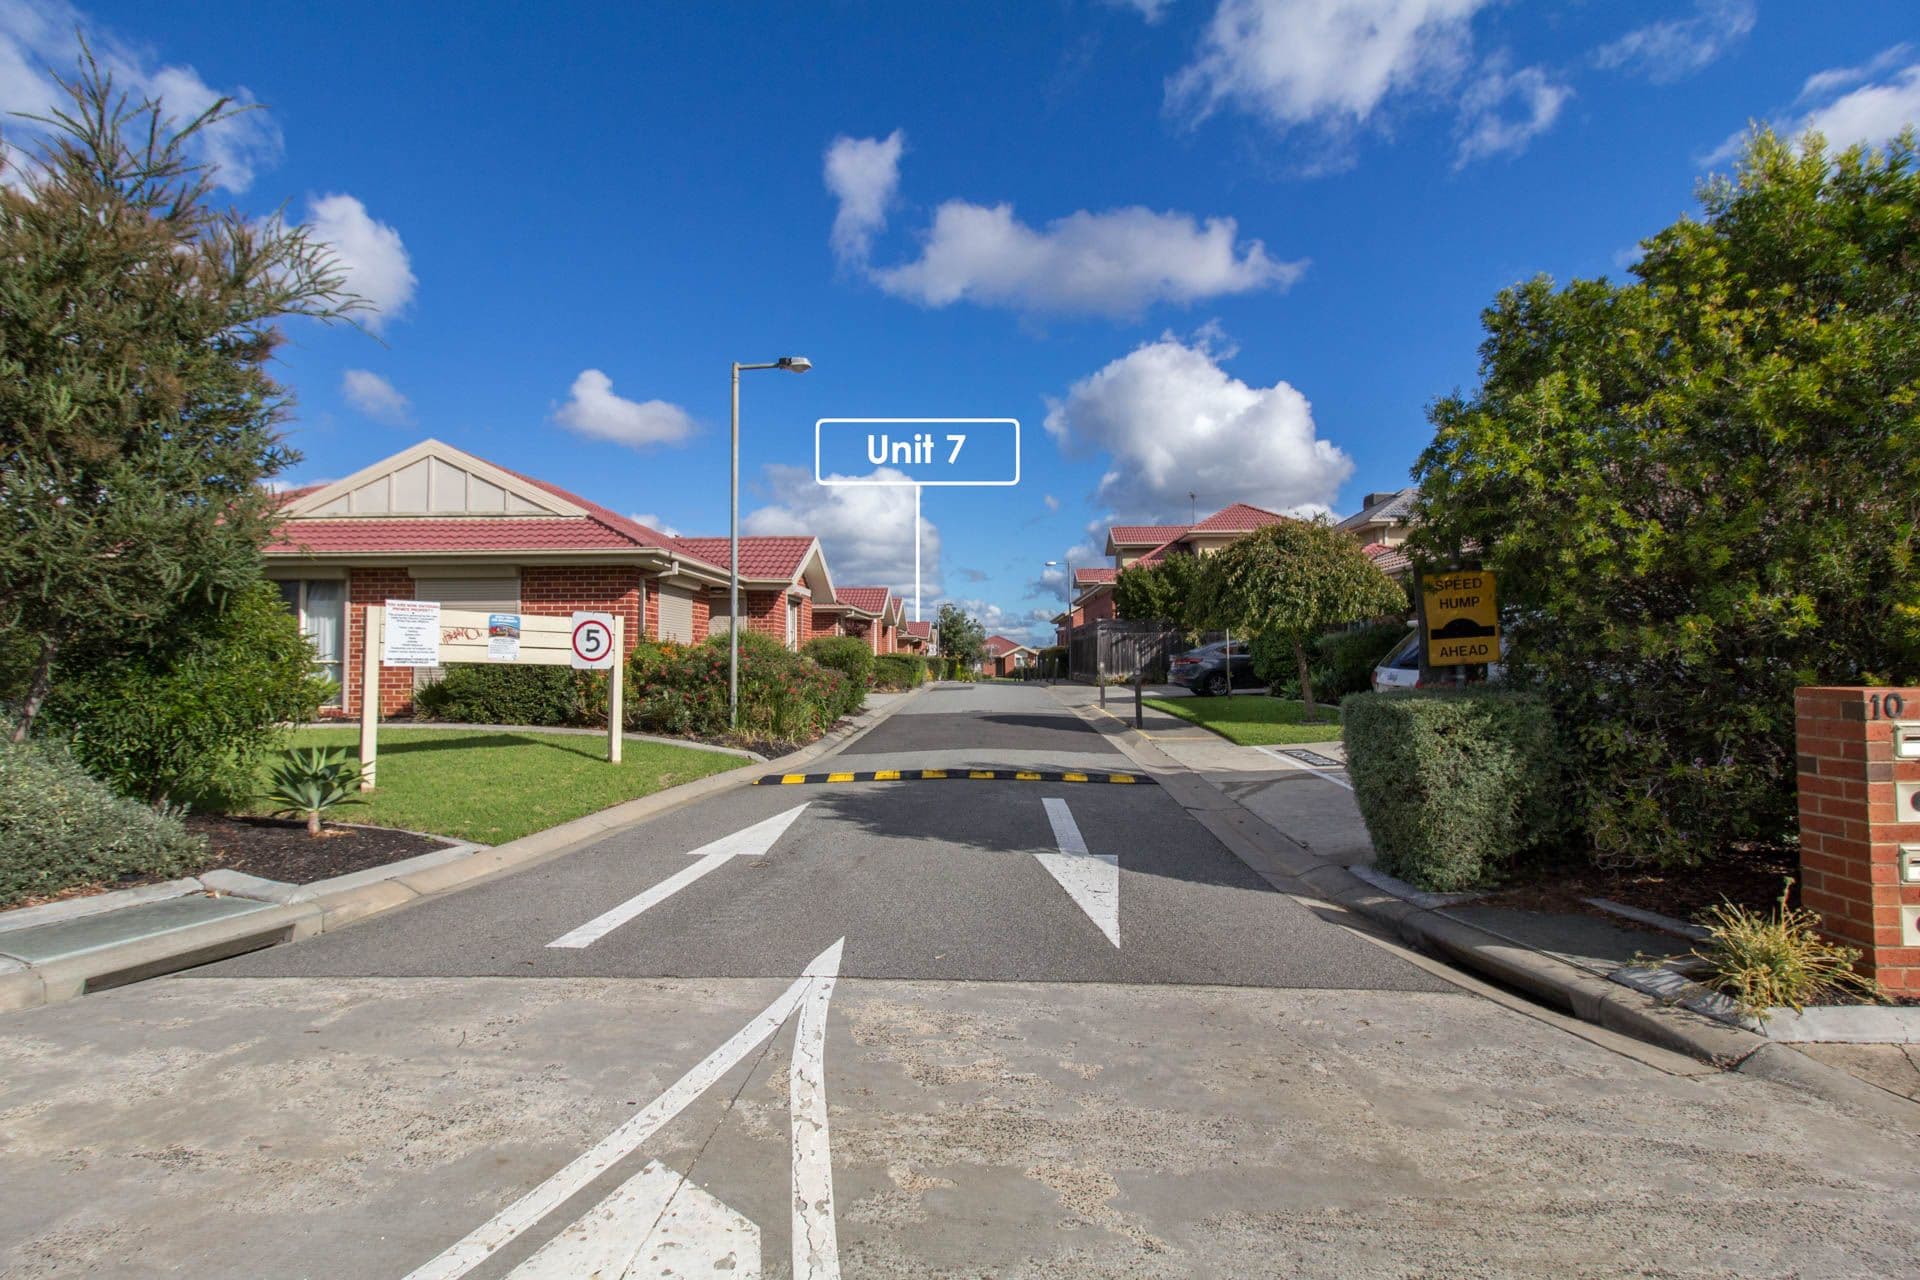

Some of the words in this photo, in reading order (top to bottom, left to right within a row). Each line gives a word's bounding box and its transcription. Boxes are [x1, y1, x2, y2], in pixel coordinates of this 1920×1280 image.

[1434, 577, 1483, 591] SPEED
[1440, 596, 1480, 609] HUMP
[585, 629, 600, 652] 5
[1440, 644, 1489, 657] AHEAD
[1869, 693, 1904, 720] 10
